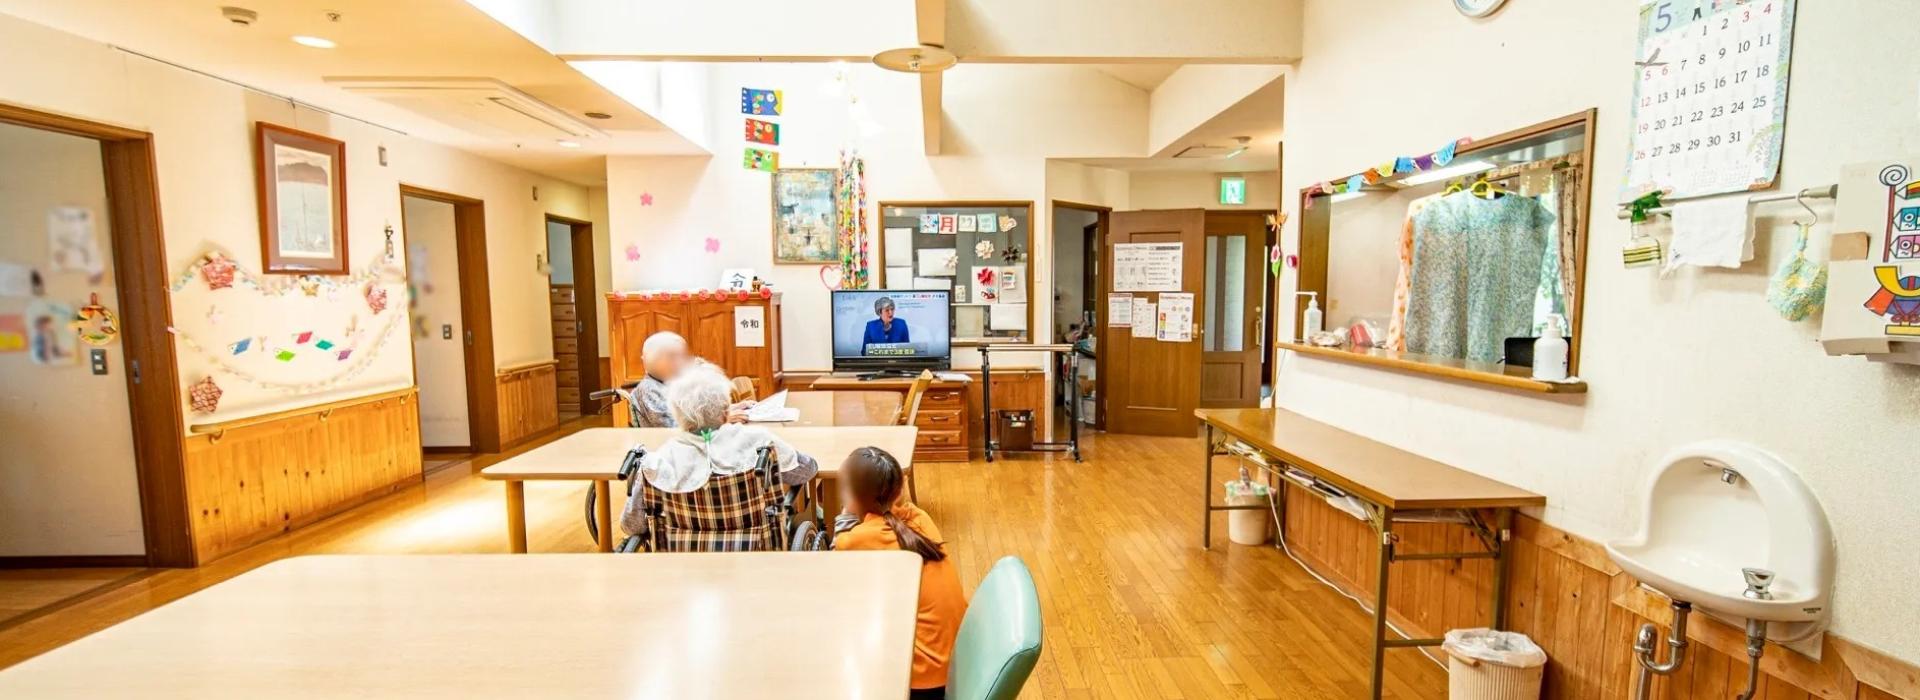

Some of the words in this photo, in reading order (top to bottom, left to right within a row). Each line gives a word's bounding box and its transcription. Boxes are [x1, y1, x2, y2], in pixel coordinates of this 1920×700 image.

[1655, 2, 1672, 33] 5
[1702, 25, 1708, 36] 1
[1721, 18, 1729, 30] 2
[1742, 11, 1750, 23] 3
[1763, 3, 1772, 15] 4
[1644, 70, 1651, 81] 5
[1662, 66, 1669, 76] 6
[1681, 59, 1687, 71] 7
[1698, 54, 1706, 65] 8
[1718, 48, 1726, 60] 9
[1737, 40, 1751, 53] 10
[1759, 34, 1772, 47] 11
[1640, 97, 1652, 108] 12
[1657, 92, 1669, 104] 13
[1675, 87, 1687, 99] 14
[1694, 82, 1706, 95] 15
[1714, 77, 1727, 89] 16
[1734, 70, 1748, 84] 17
[1756, 65, 1770, 78] 18
[1638, 123, 1649, 135] 19
[1654, 119, 1667, 131] 20
[1671, 115, 1684, 127] 21
[1690, 110, 1704, 123] 22
[1710, 106, 1724, 119] 23
[1730, 100, 1745, 114] 24
[1752, 95, 1767, 110] 25
[1635, 150, 1646, 161] 26
[1651, 146, 1664, 158] 27
[1669, 143, 1681, 155] 28
[1687, 138, 1701, 151] 29
[1706, 135, 1721, 148] 30
[1728, 130, 1742, 144] 31
[740, 319, 760, 329] 令和
